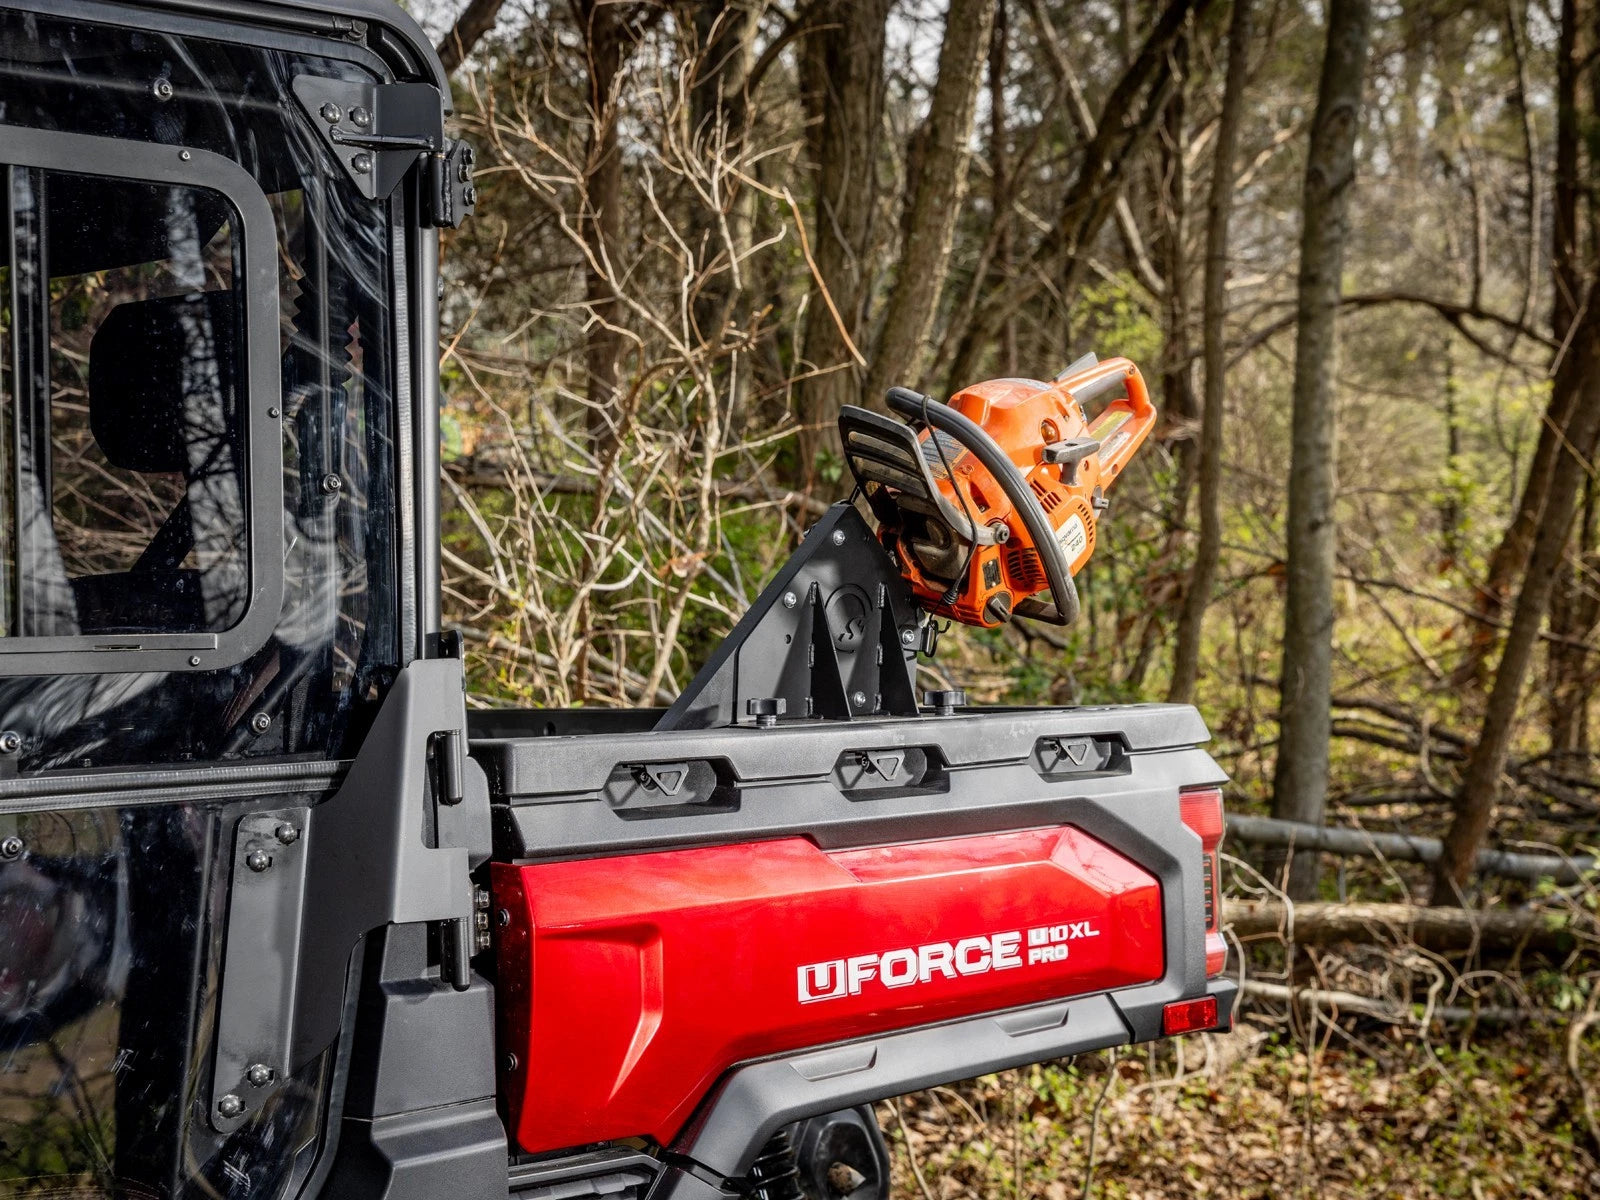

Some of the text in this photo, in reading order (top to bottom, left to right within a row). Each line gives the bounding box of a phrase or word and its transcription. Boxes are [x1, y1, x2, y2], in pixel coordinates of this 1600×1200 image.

[1071, 535, 1083, 552] 240
[1028, 943, 1069, 966] PRO
[797, 931, 1022, 1005] UFORCE
